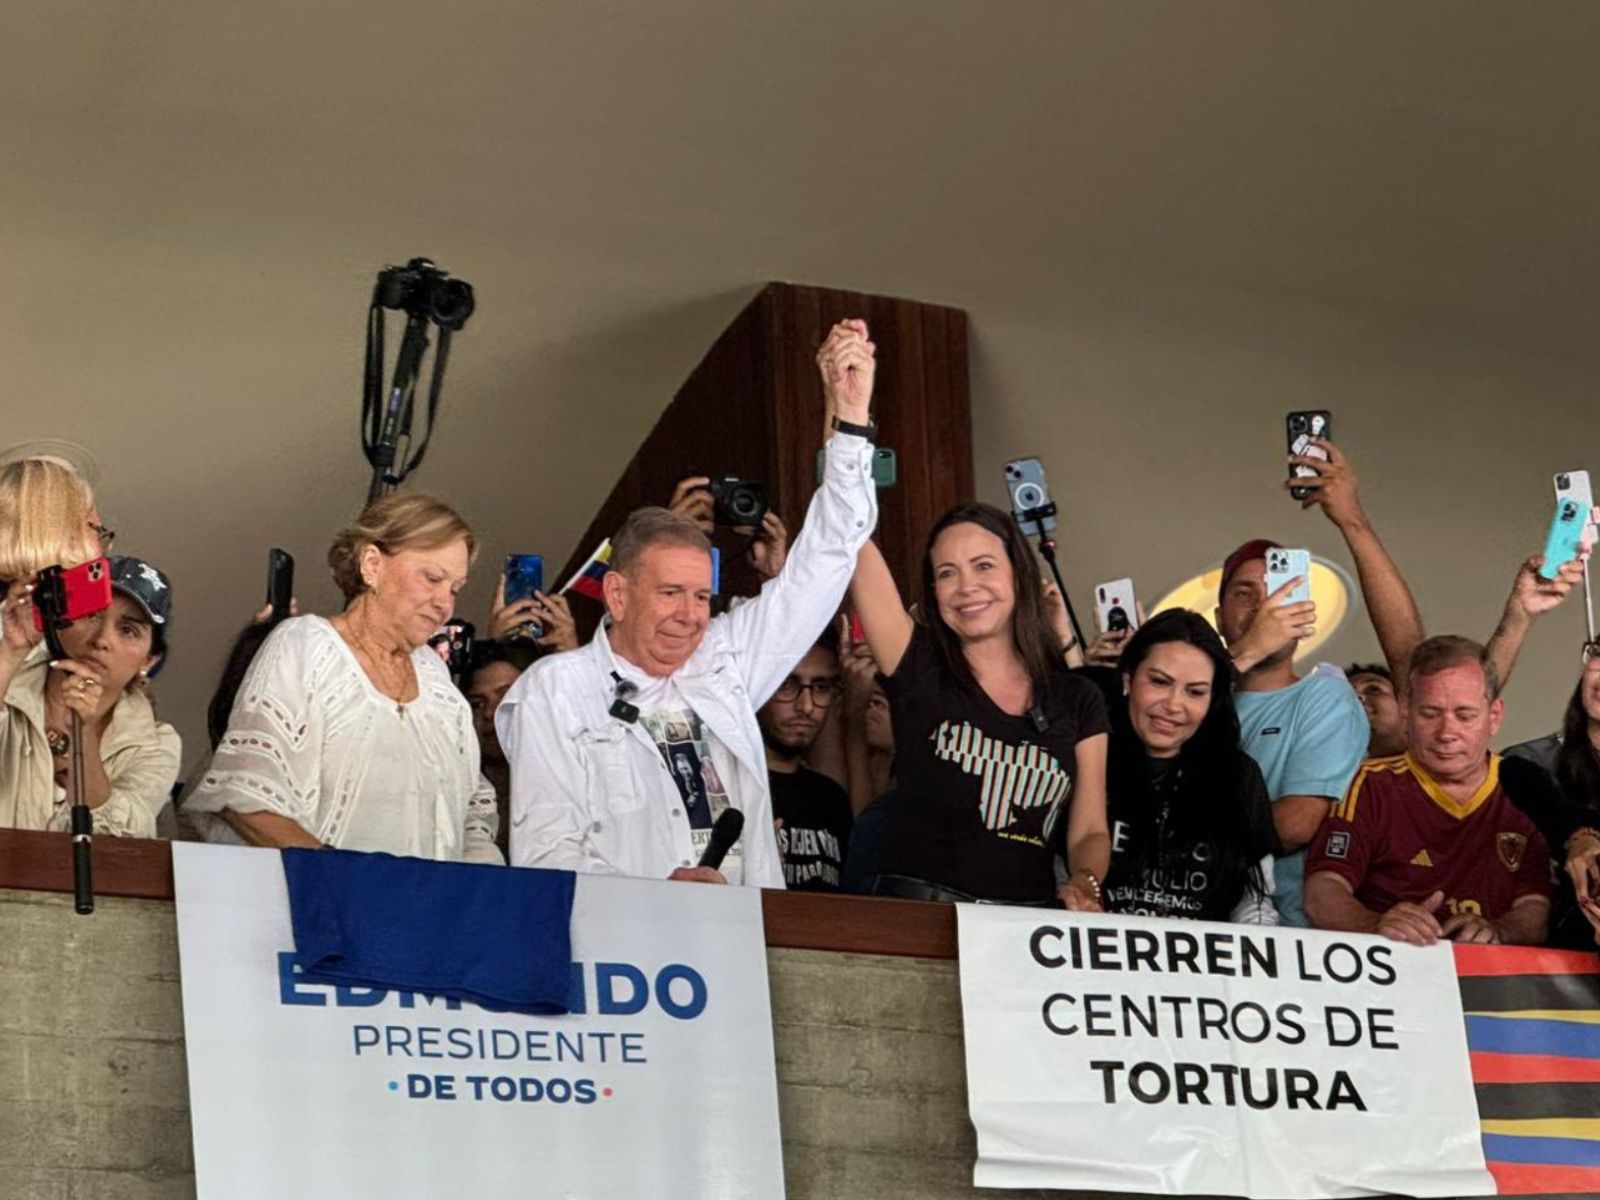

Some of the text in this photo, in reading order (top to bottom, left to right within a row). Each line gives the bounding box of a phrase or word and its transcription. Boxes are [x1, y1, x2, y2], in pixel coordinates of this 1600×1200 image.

[1030, 925, 1397, 985] CIERREN LOS
[353, 1025, 647, 1063] PRESIDENTE
[1042, 993, 1399, 1050] CENTROS DE
[407, 1074, 597, 1103] DE TODOS
[1090, 1061, 1368, 1111] TORTURA
